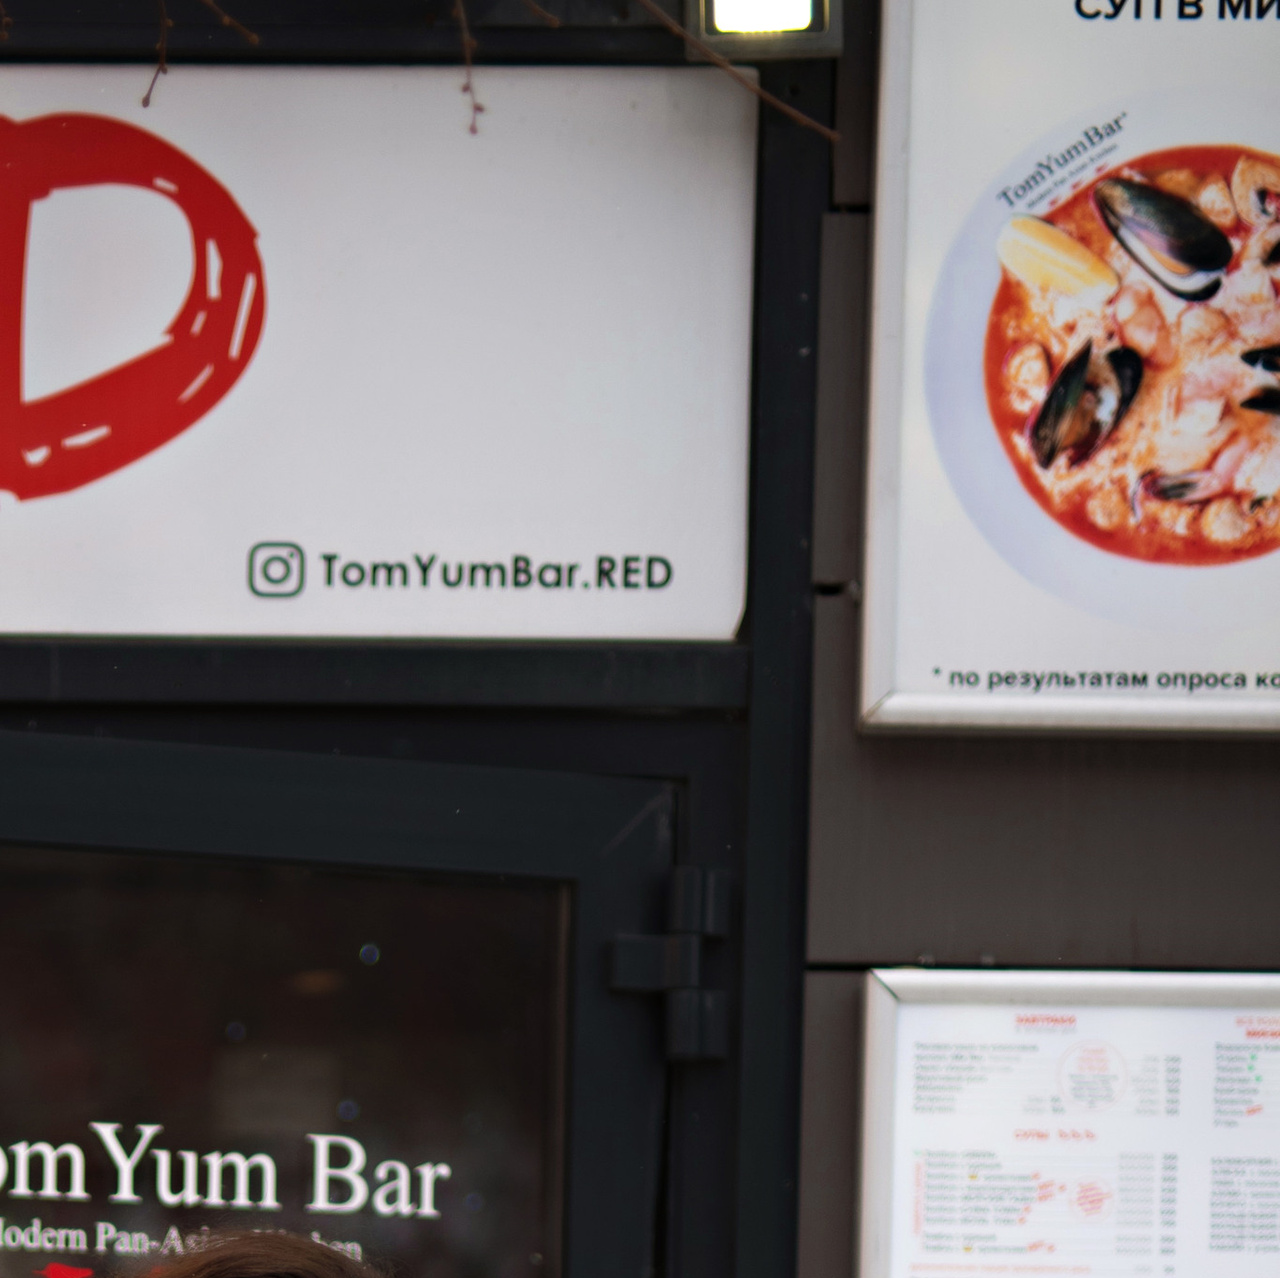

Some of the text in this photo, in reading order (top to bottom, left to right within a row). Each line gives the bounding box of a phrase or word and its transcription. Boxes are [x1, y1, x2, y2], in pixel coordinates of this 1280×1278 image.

[321, 553, 673, 590] TomYumBar.RED
[949, 669, 980, 688] по
[987, 669, 1148, 693] результатам
[1156, 670, 1248, 693] опроса
[305, 1132, 453, 1220] Bar
